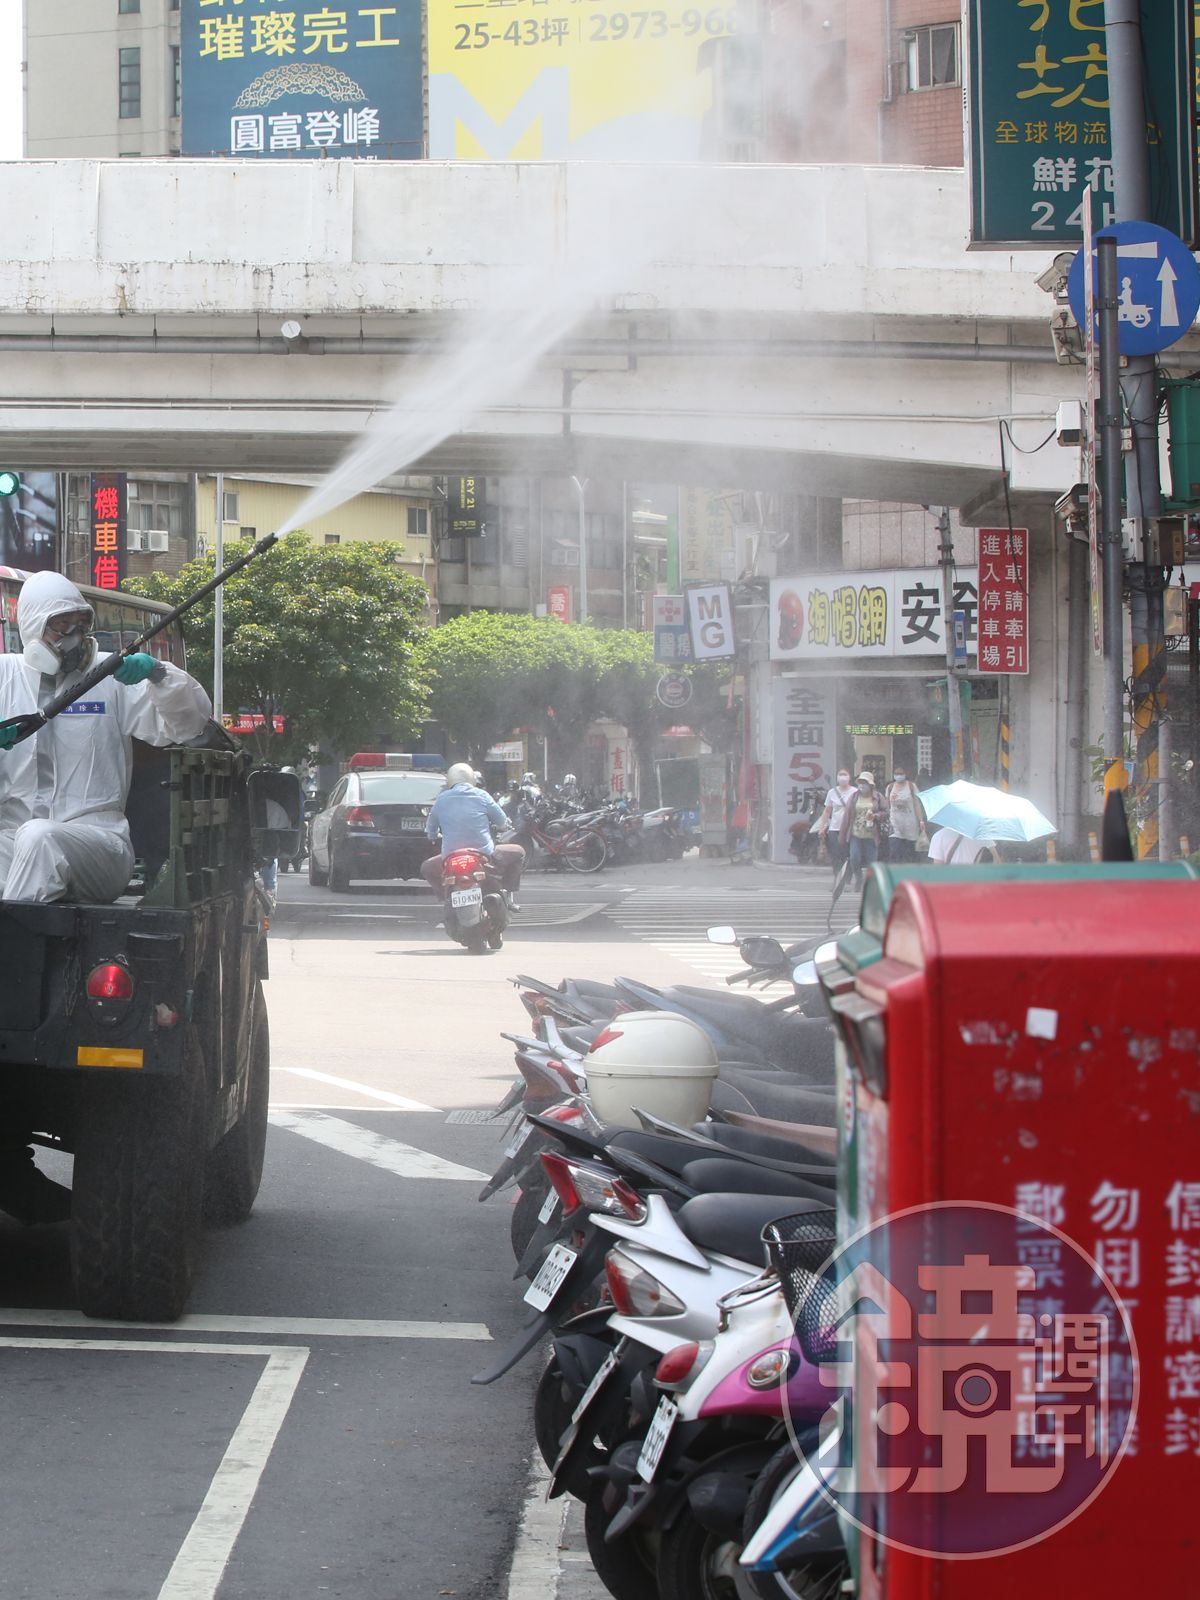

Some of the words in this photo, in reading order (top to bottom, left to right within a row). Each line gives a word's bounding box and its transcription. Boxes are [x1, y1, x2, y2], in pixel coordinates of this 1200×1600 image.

[200, 8, 399, 60] 璀璨完工
[454, 18, 569, 50] 25-43坪
[231, 107, 380, 154] 圓富登峰
[94, 487, 118, 589] 機車借
[982, 536, 1001, 667] 進入停車場
[1004, 536, 1023, 667] 機車請牽引
